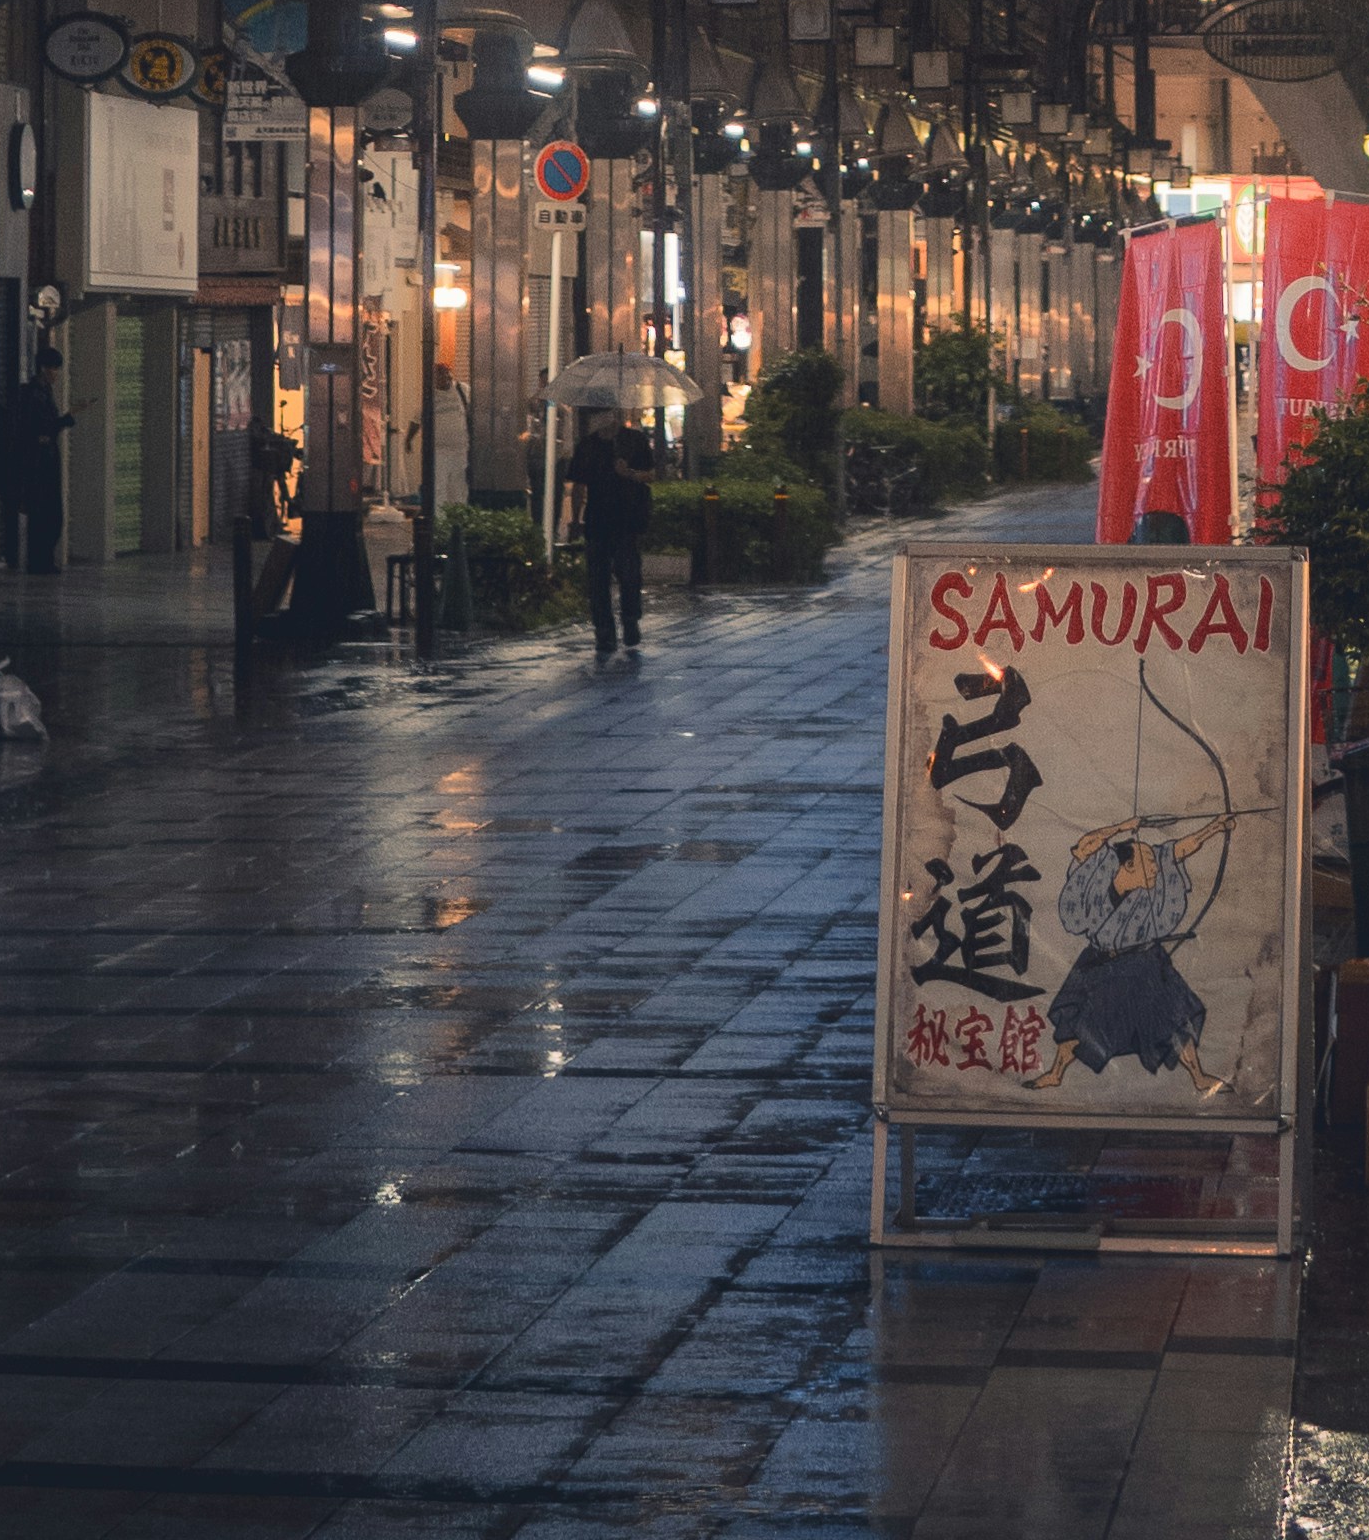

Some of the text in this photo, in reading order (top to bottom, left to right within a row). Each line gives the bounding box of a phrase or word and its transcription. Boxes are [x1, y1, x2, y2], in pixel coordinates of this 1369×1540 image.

[929, 571, 1274, 655] SAMURAI
[910, 664, 1047, 1002] 弓道
[907, 1002, 1048, 1075] 秘宝館
